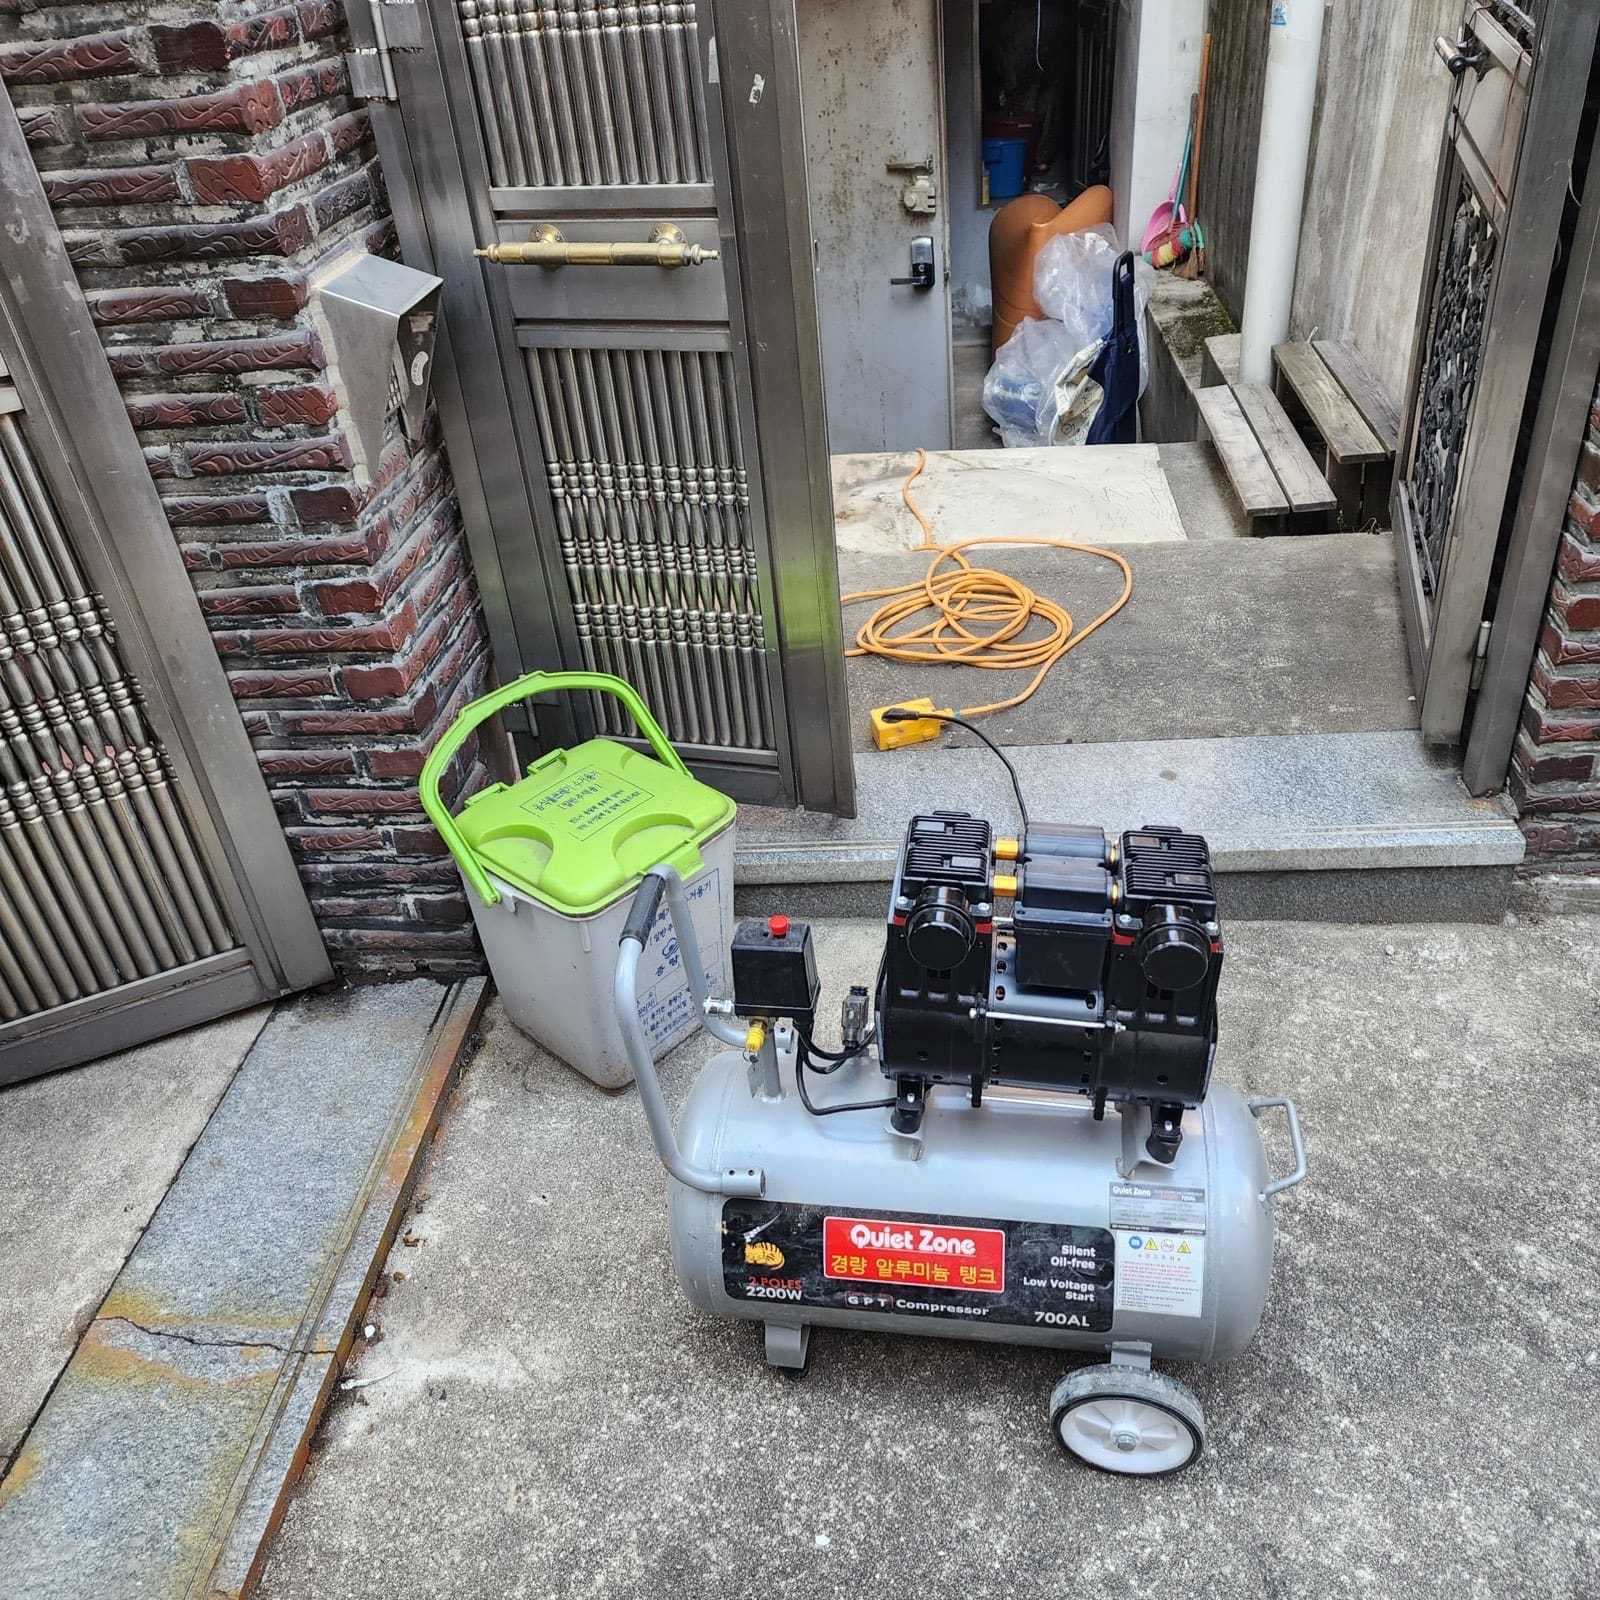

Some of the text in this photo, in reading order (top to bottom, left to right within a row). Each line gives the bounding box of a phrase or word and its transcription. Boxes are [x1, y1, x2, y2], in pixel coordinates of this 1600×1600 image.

[850, 1224, 976, 1255] Quiet Zone
[1061, 1245, 1096, 1258] Silent
[831, 1254, 997, 1285] 경량 알루미늄 탱크
[1050, 1256, 1096, 1270] Oil-free
[761, 1277, 802, 1290] POLES
[1023, 1277, 1095, 1293] Low Voltage
[746, 1286, 802, 1300] 2200W
[1065, 1291, 1095, 1302] Start
[896, 1299, 989, 1316] Compressor
[1034, 1311, 1090, 1327] 700AL
